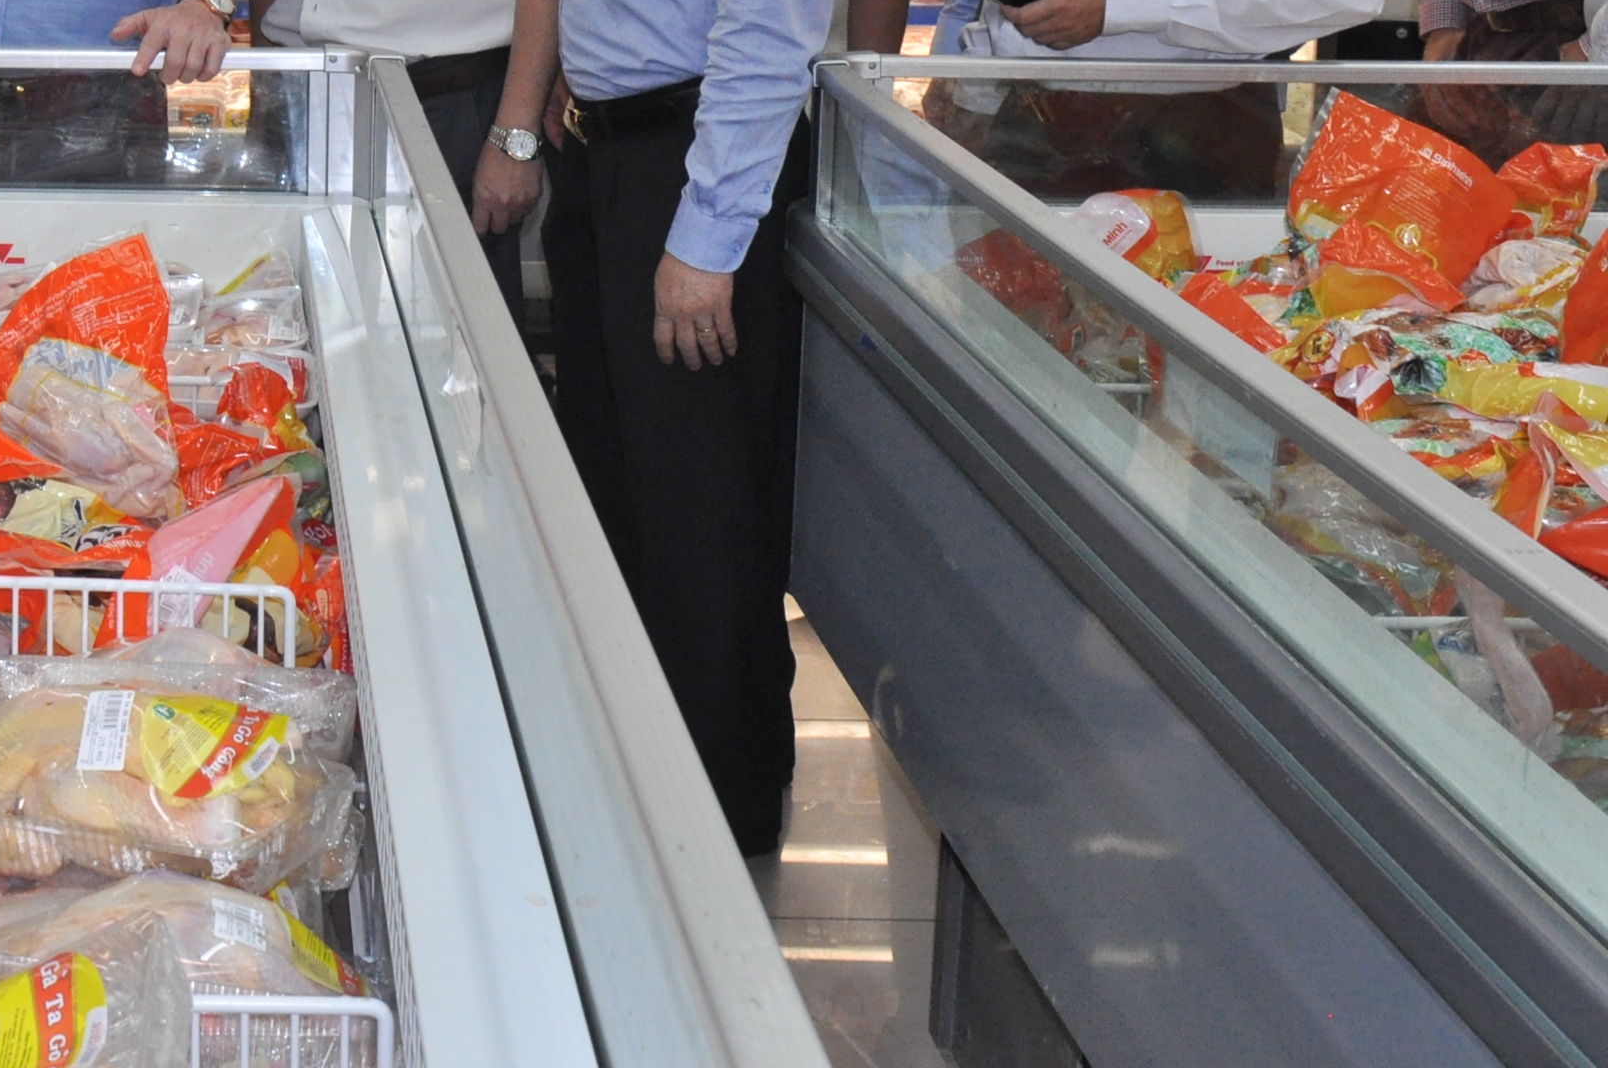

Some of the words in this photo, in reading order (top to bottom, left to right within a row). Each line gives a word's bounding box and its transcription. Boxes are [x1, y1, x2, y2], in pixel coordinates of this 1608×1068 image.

[1102, 220, 1129, 247] Minh
[1215, 259, 1235, 267] Food
[201, 747, 237, 781] Công
[40, 960, 69, 990] Gà
[45, 993, 64, 1027] Ta
[48, 1033, 72, 1062] Gò
